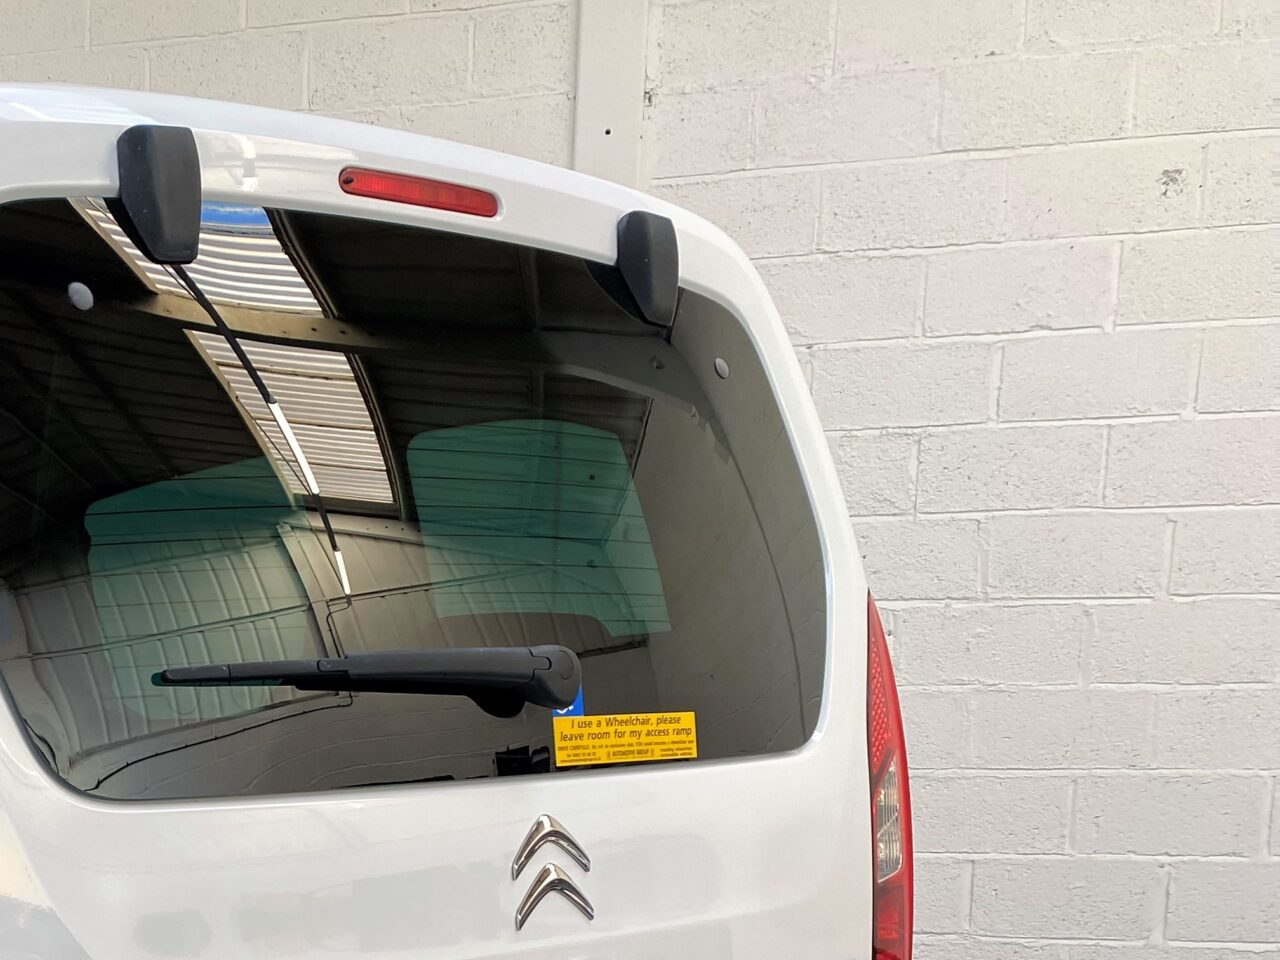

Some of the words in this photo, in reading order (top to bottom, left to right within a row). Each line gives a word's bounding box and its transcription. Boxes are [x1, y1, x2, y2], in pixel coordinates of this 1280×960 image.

[571, 720, 575, 729] I
[577, 720, 592, 728] use
[596, 720, 602, 728] a
[605, 716, 653, 727] Wheelchair,
[656, 715, 681, 727] please
[560, 731, 584, 742] leave
[587, 732, 610, 740] room
[614, 729, 626, 739] for
[629, 730, 642, 740] my
[645, 729, 669, 737] access
[672, 727, 692, 737] ramp
